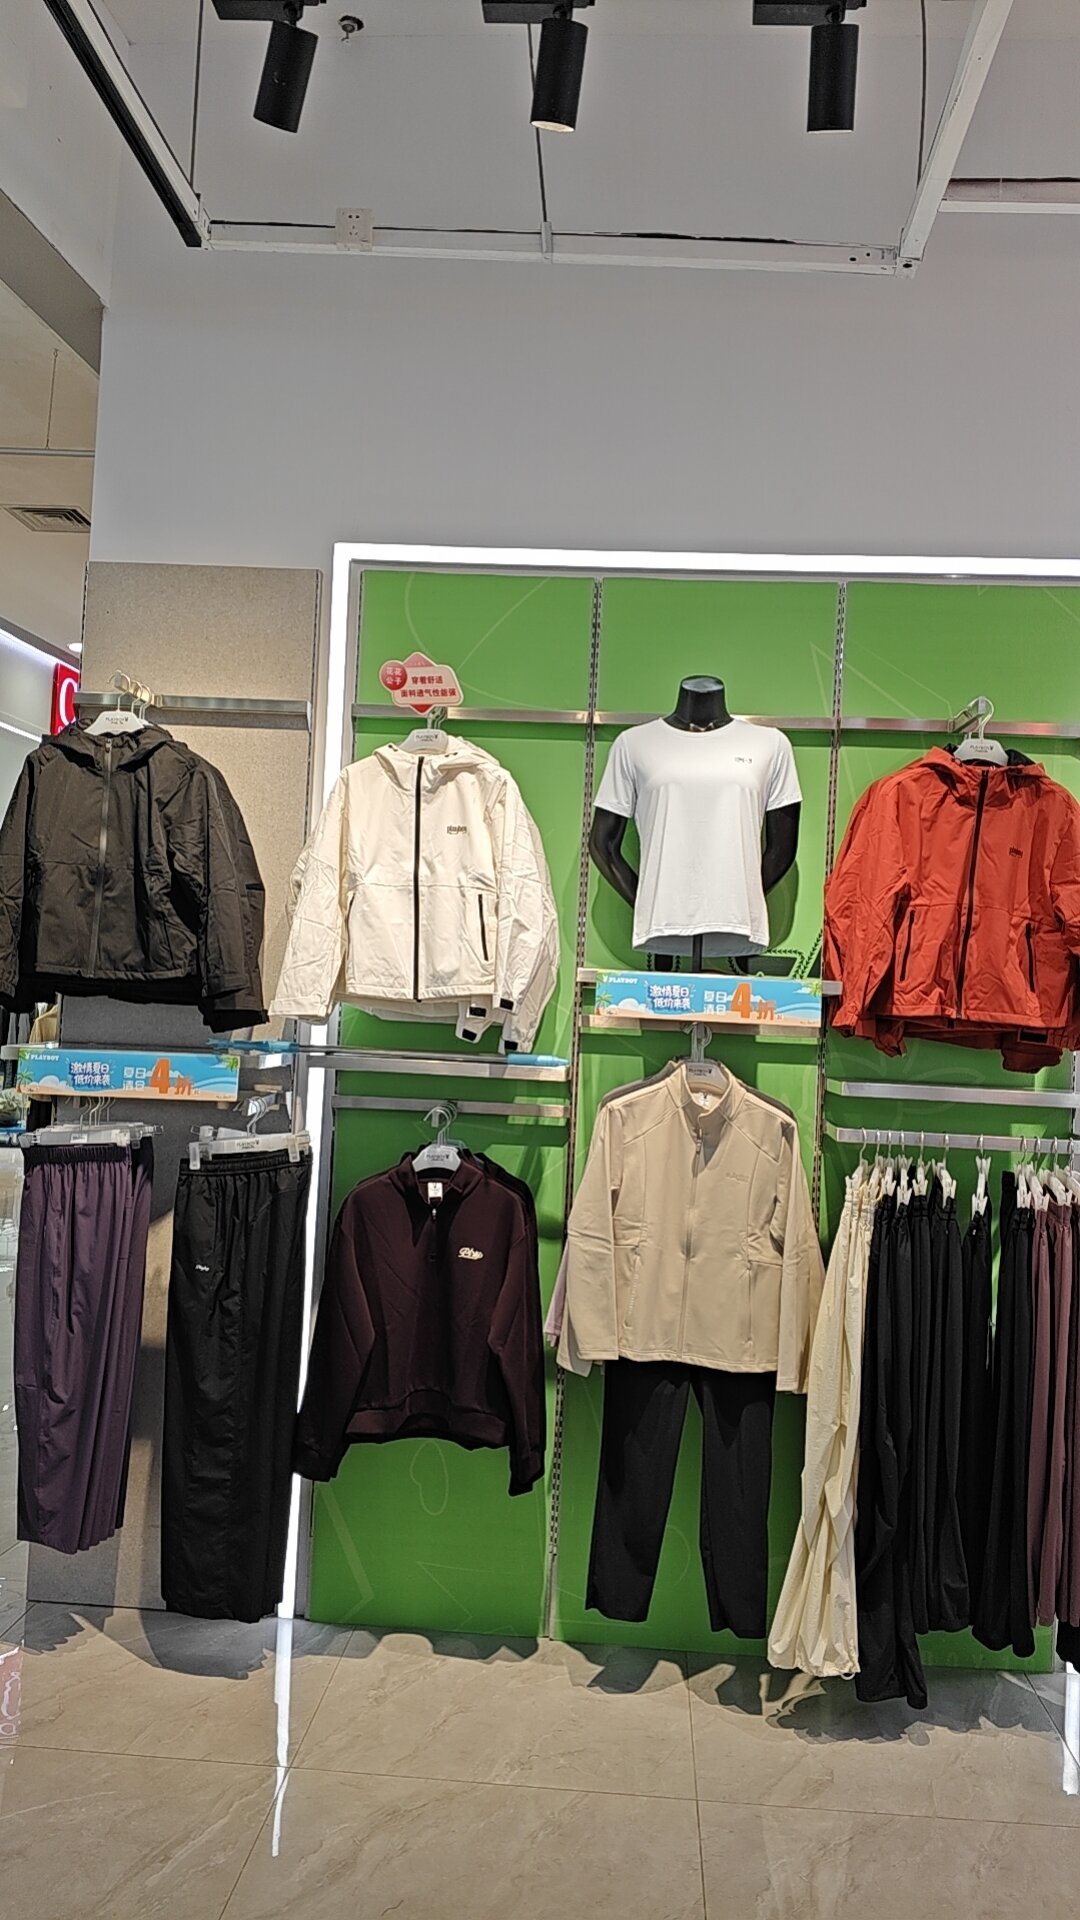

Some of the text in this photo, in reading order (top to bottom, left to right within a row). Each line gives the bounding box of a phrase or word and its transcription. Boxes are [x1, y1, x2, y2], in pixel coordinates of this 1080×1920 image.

[411, 675, 443, 685] 穿着舒适
[401, 688, 457, 697] 面料透气性能强
[650, 984, 689, 997] 激情夏日
[654, 998, 690, 1009] 低价来袭
[30, 1054, 60, 1062] PLAYBOY
[71, 1062, 110, 1074] 激情夏日
[74, 1075, 110, 1086] 低价来袭
